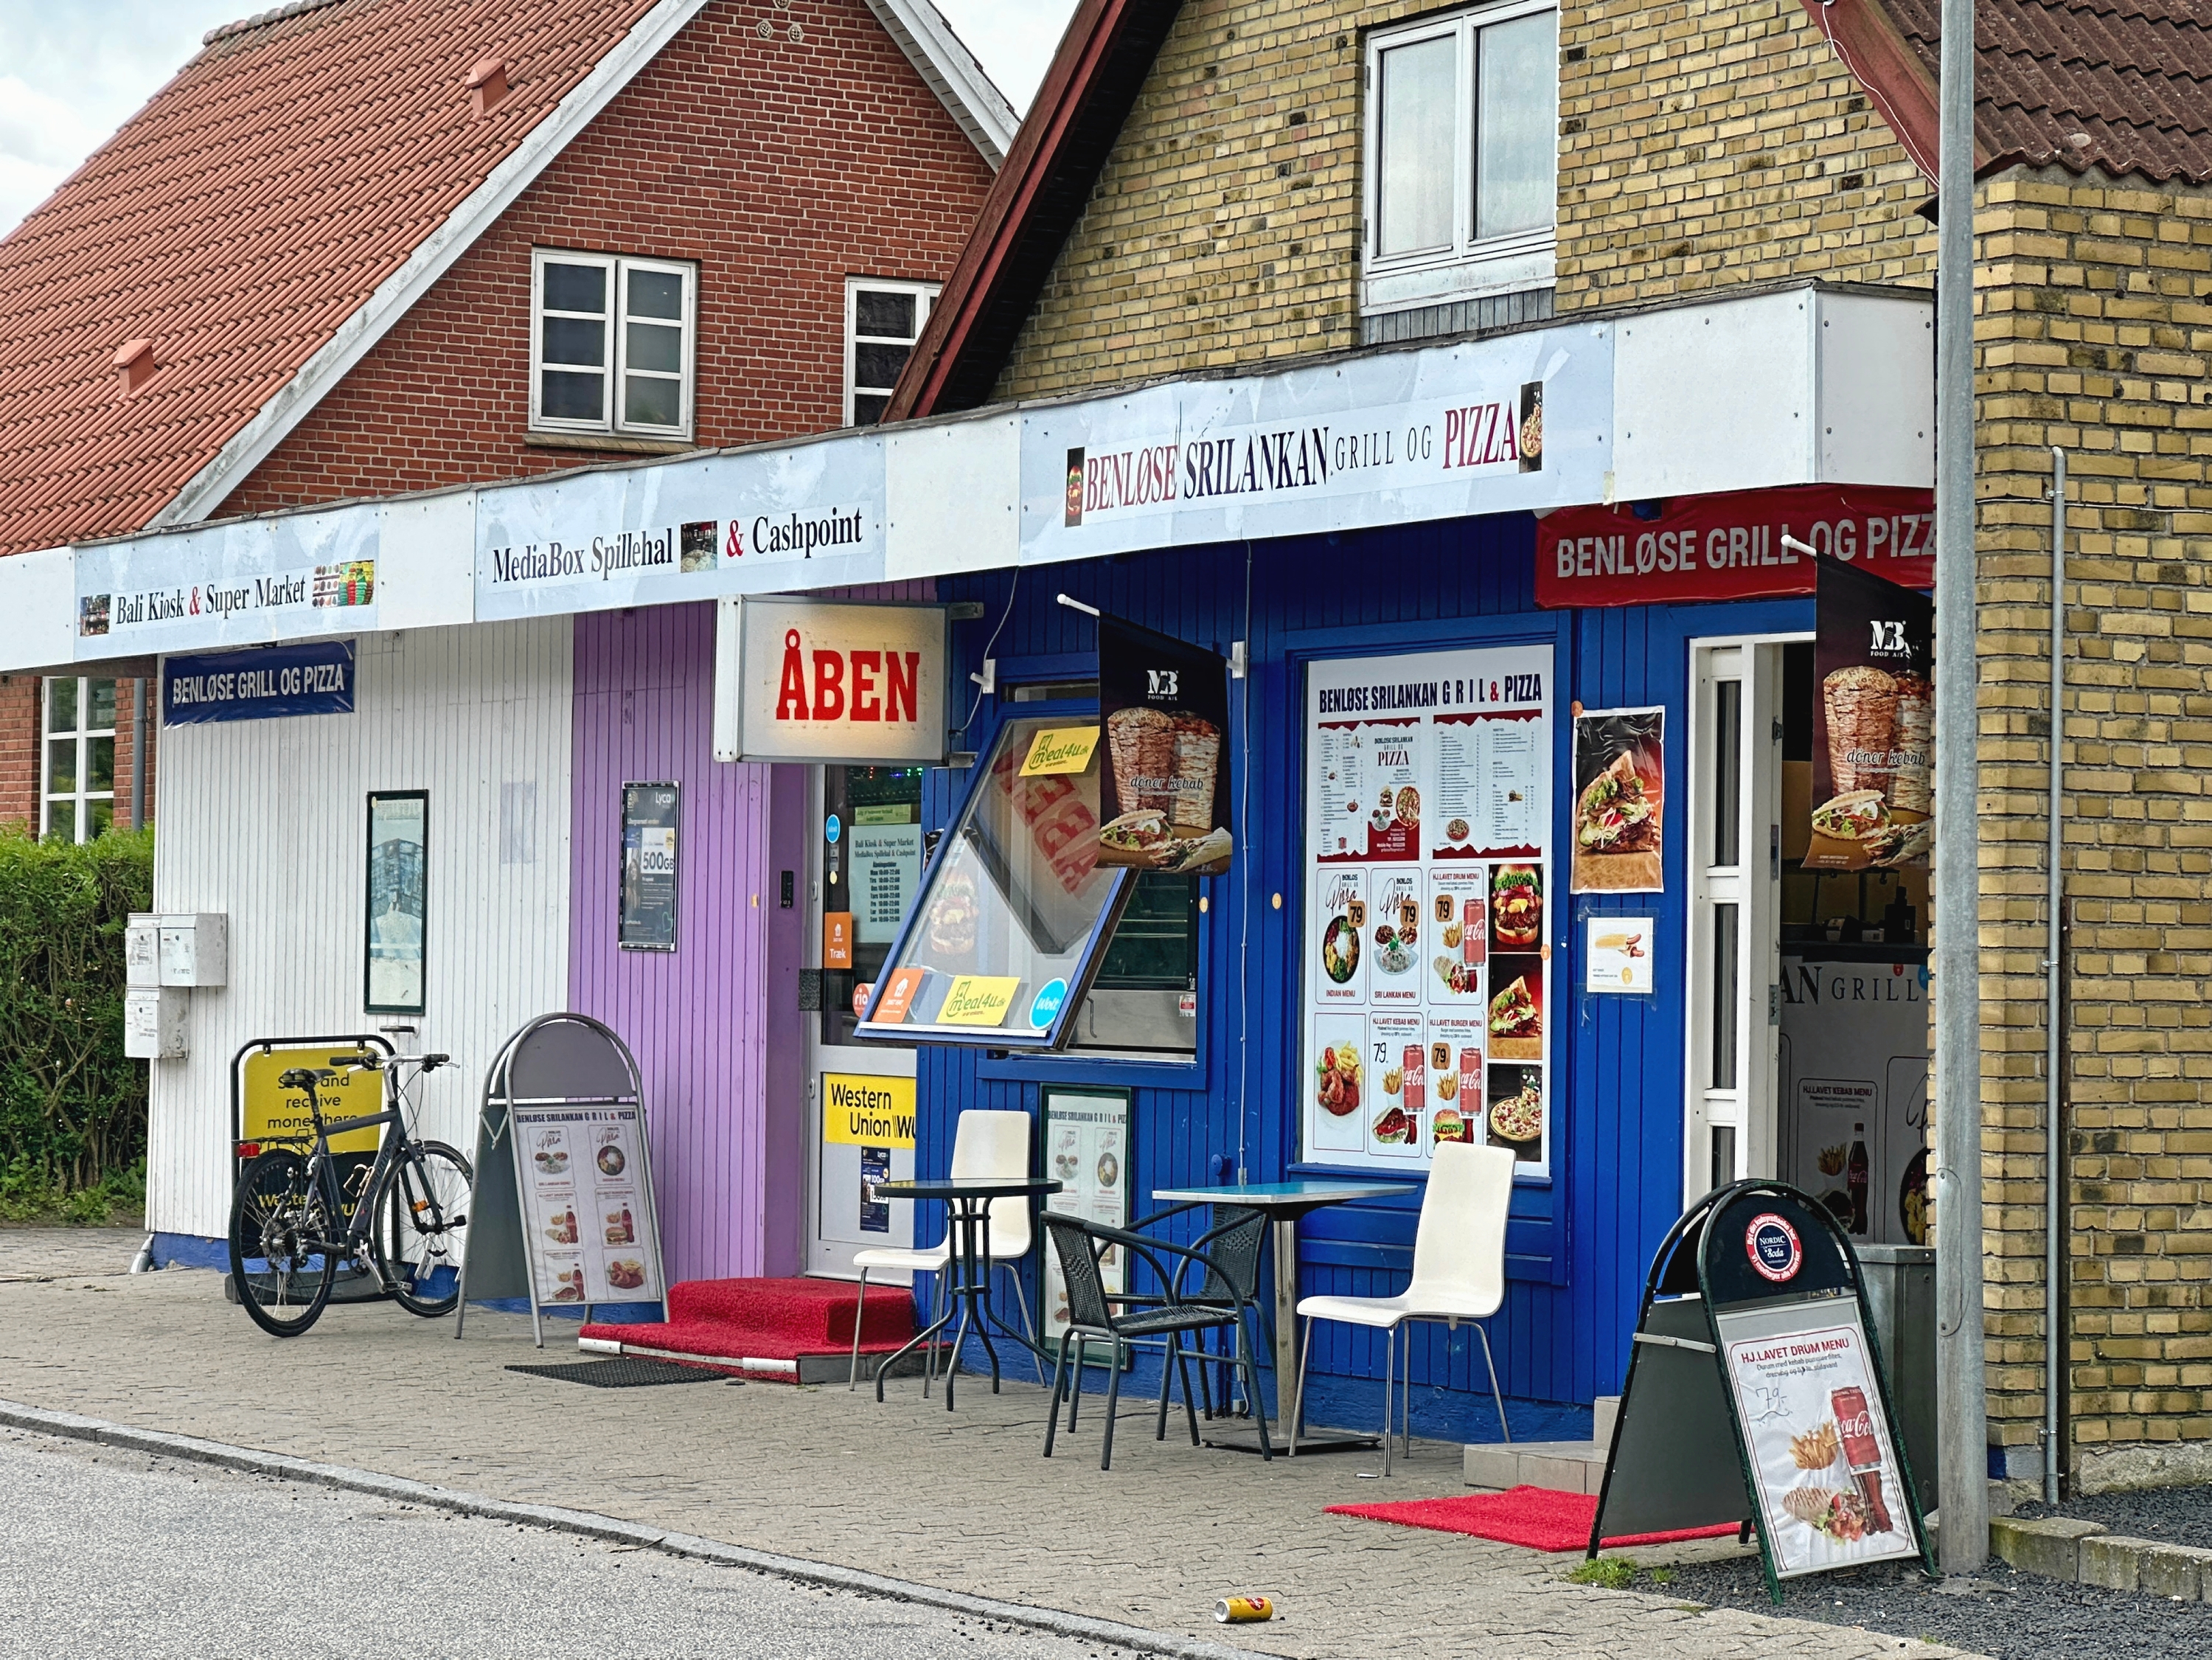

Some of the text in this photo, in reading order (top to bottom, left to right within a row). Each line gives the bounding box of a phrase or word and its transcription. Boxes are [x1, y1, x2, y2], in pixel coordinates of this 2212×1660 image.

[1085, 401, 1519, 513] BENLØSE SRILANKAN GRILL OG PIZZA
[493, 507, 863, 583] MediaBox Spillehal & Cashpoint
[1557, 515, 1937, 578] BENLØSE GRILL OG PIZZ
[116, 574, 306, 625] Bali Kiosk & Super Market
[173, 662, 345, 705] BENLØSE GRILL OG PIZZA
[776, 628, 920, 722] ÅBEN
[1319, 687, 1368, 713] BENLØSE
[1371, 682, 1438, 711] SRILANKAN
[1489, 681, 1499, 702] &
[1504, 673, 1542, 703] PIZZA
[1377, 751, 1409, 766] PIZZA
[1846, 748, 1926, 768] döner kebab
[1130, 775, 1204, 790] döner kebab
[865, 839, 877, 847] Kiosk
[883, 838, 897, 848] Super
[897, 838, 914, 846] Market
[1350, 906, 1363, 923] 79
[1402, 906, 1416, 923] 79
[1437, 900, 1450, 919] 79
[830, 948, 846, 959] Træk
[1831, 976, 1919, 1001] GRILL
[1036, 996, 1062, 1011] Wolt
[1435, 1048, 1447, 1063] 79
[321, 1074, 349, 1088] and
[286, 1094, 341, 1108] recive
[831, 1083, 891, 1110] Western
[618, 1111, 636, 1119] PIZZA
[849, 1111, 891, 1138] Union
[1759, 1235, 1787, 1246] NORDIC
[1767, 1247, 1784, 1258] Soda
[1741, 1338, 1850, 1364] HJ.LAVET DRUM MENU
